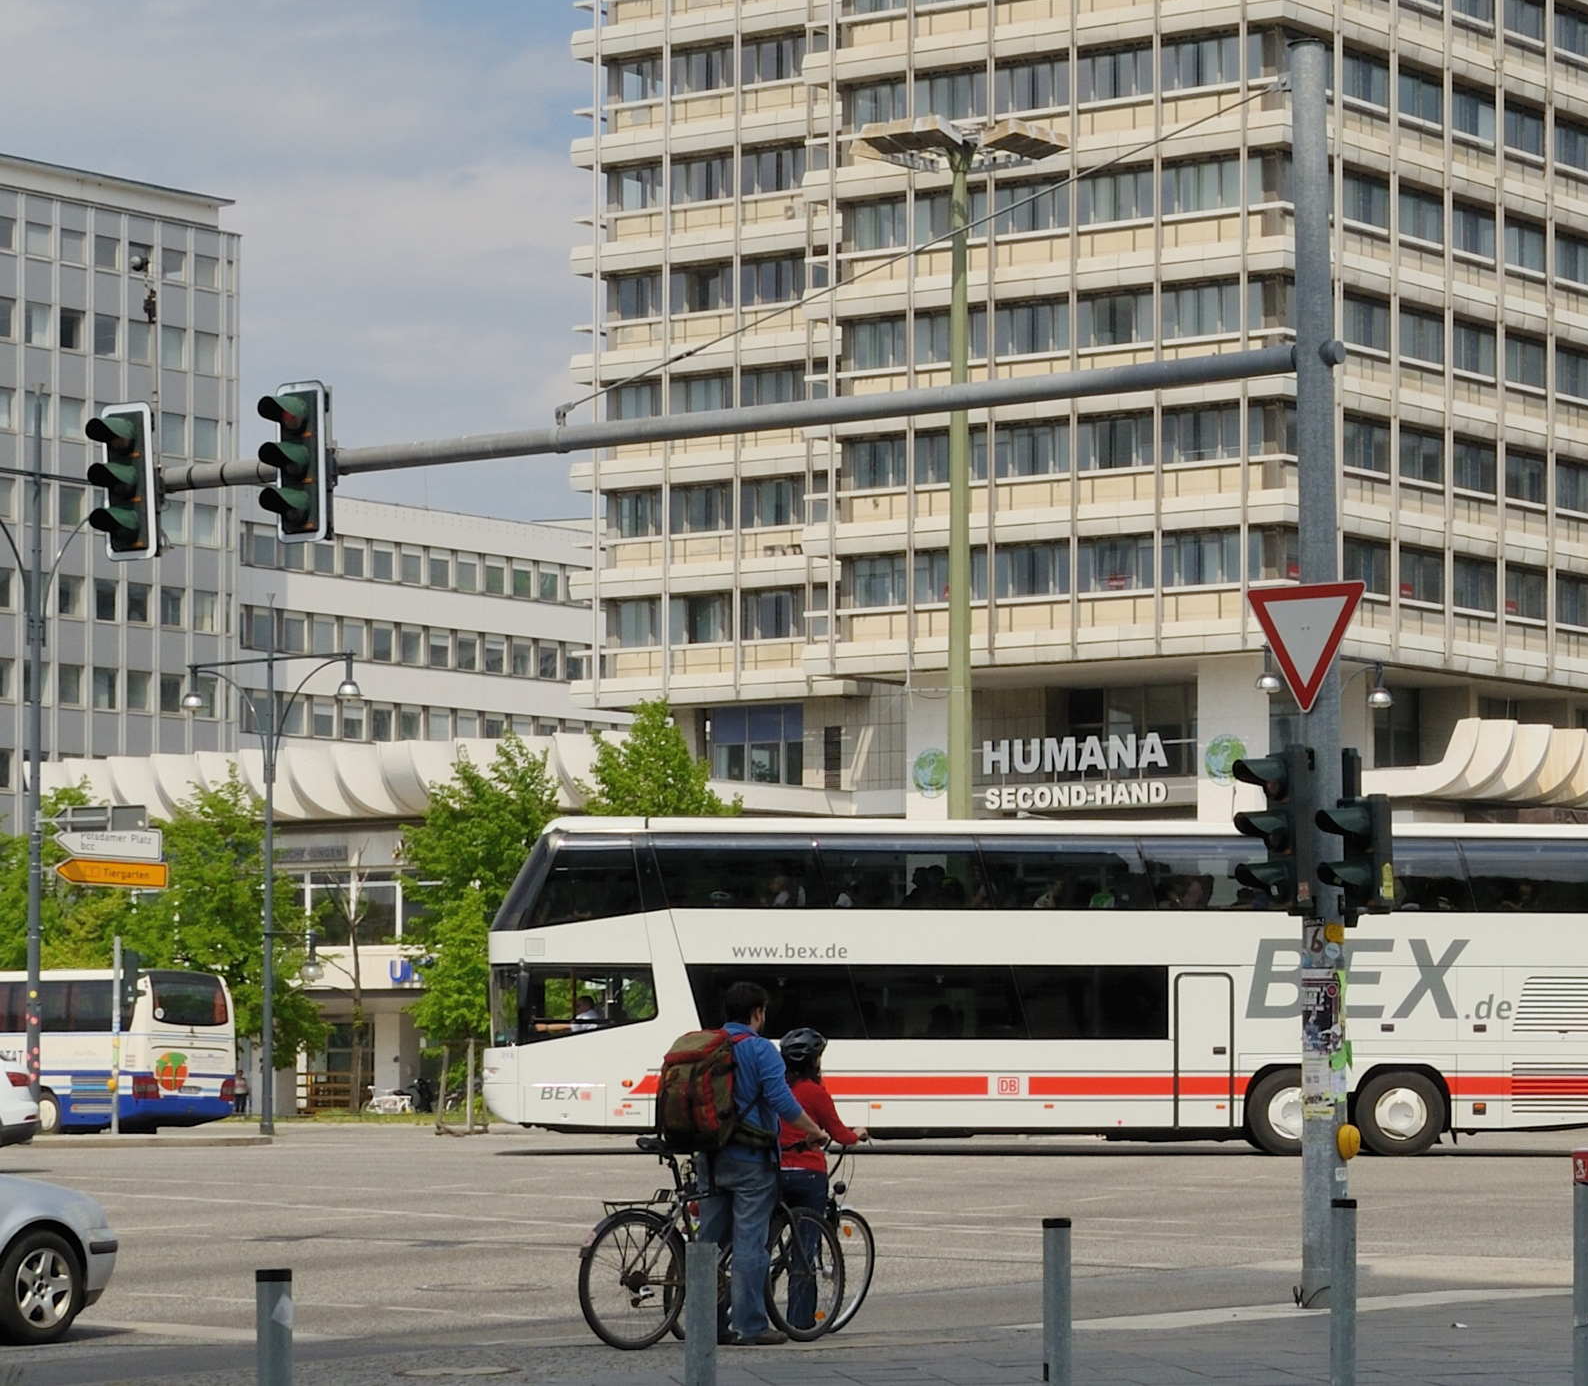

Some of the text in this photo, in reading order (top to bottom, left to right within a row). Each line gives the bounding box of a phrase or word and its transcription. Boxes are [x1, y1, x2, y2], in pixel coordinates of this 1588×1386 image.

[982, 732, 1169, 775] HUMANA
[985, 781, 1168, 810] SECOND-HAND
[80, 832, 152, 845] Potsdamer Platz
[80, 842, 95, 851] bcc
[104, 868, 150, 881] Tiergarten
[732, 943, 848, 959] www.bex.de
[1000, 1078, 1018, 1093] DB
[540, 1086, 580, 1101] BEX
